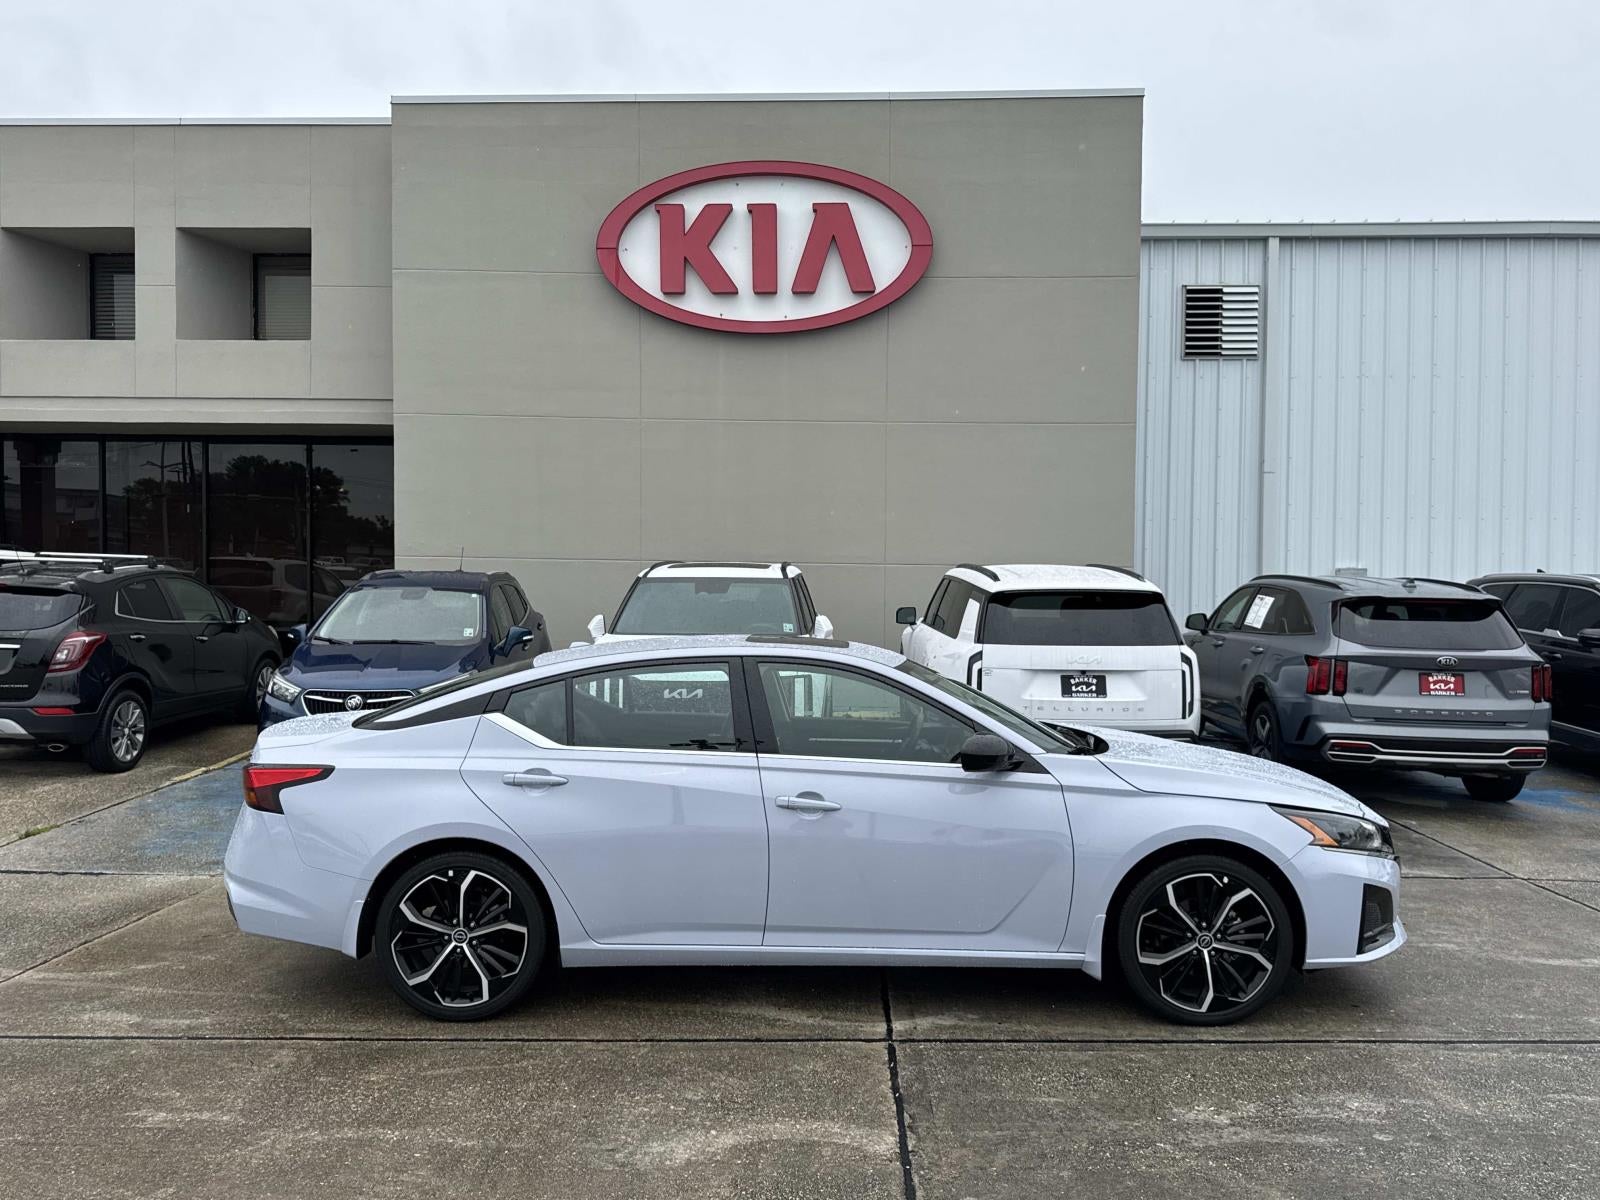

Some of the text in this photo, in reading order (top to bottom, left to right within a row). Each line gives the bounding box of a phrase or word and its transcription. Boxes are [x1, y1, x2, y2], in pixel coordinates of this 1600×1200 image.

[655, 203, 876, 295] KIA
[1070, 677, 1097, 685] BARKER
[1428, 675, 1456, 683] BARKER
